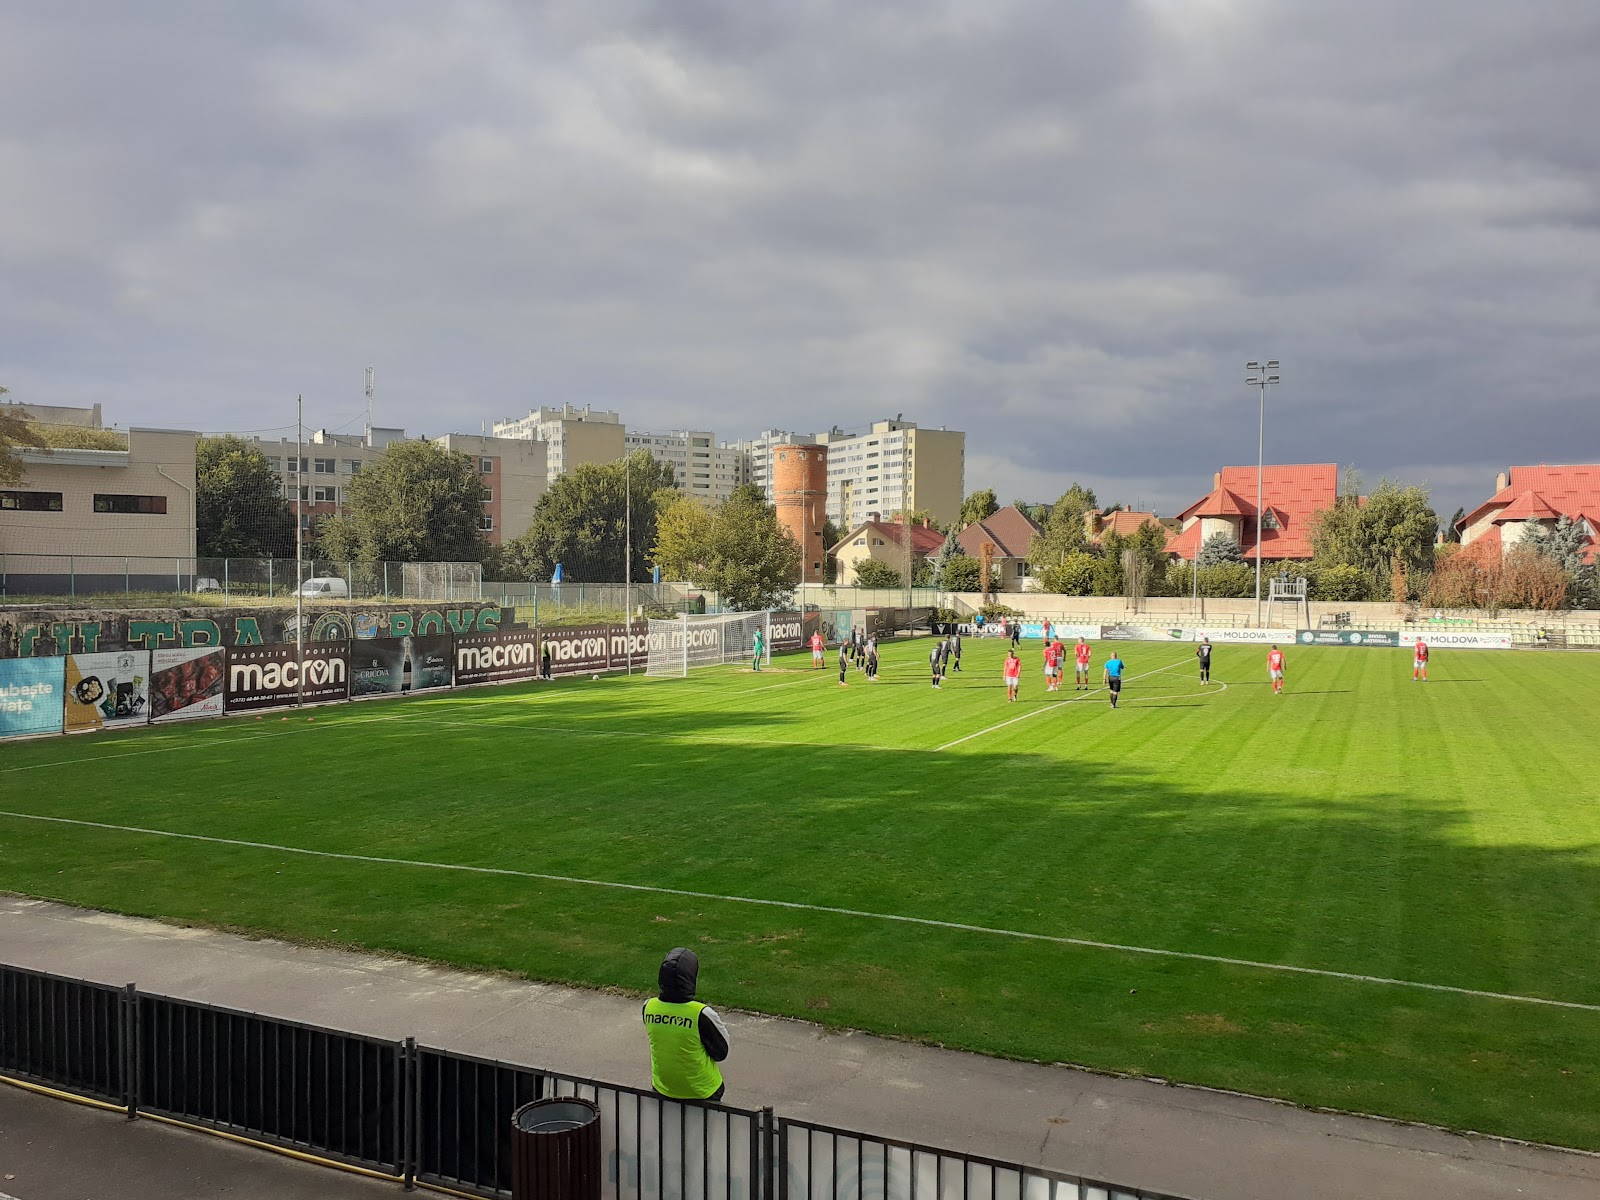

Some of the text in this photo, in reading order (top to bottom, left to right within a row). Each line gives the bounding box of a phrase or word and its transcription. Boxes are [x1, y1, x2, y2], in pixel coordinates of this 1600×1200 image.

[388, 607, 501, 637] BOYS
[458, 633, 535, 645] MAGAZIN SPORTIV
[1073, 629, 1097, 637] Origini
[1223, 631, 1267, 639] MOLDOVA
[611, 632, 667, 655] macron
[230, 647, 346, 660] MAGAZIN PORTIV
[458, 642, 534, 671] macron
[230, 657, 346, 693] macron
[360, 669, 389, 678] CRICOVA
[645, 1013, 693, 1028] macron
